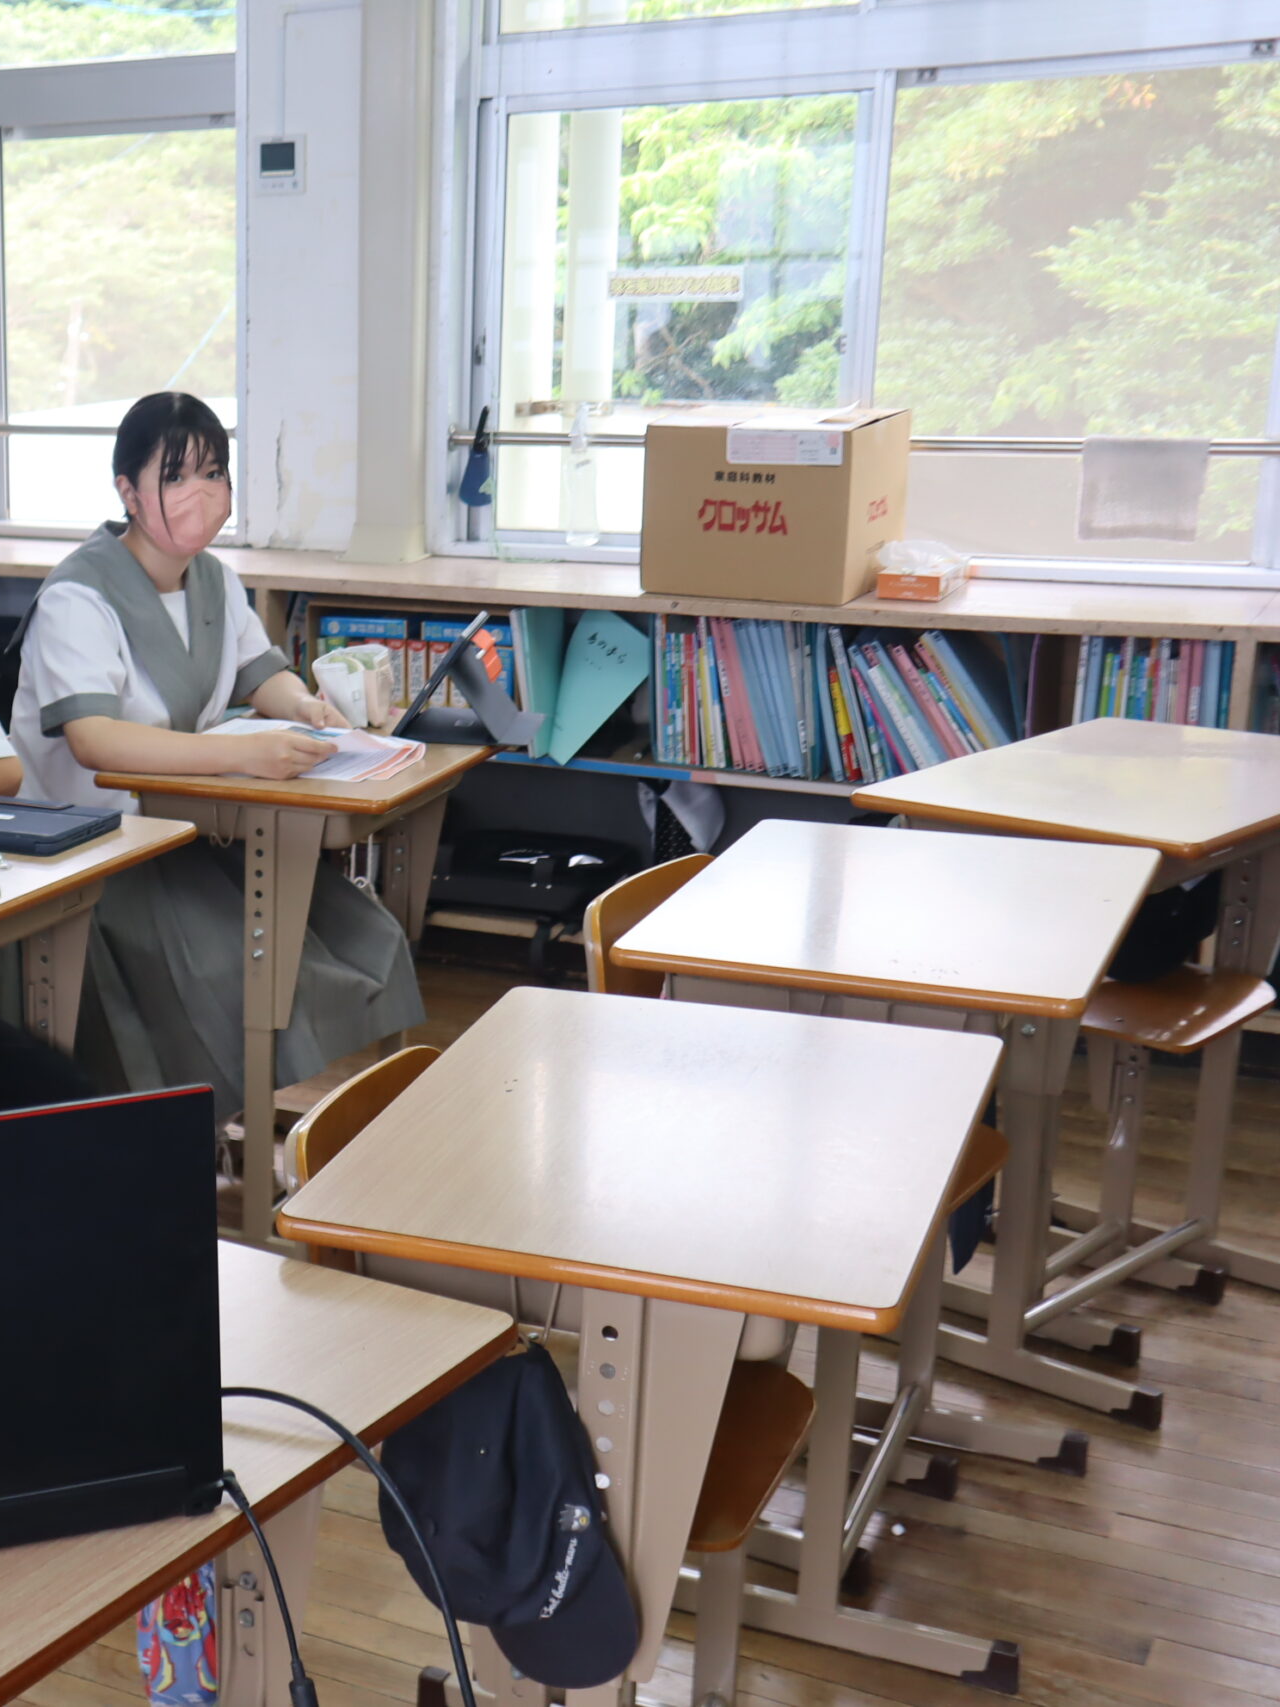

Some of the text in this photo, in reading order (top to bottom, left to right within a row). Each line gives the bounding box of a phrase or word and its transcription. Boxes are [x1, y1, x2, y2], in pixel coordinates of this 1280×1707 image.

[714, 470, 776, 485] 家庭科教材
[697, 498, 789, 536] クロッサム
